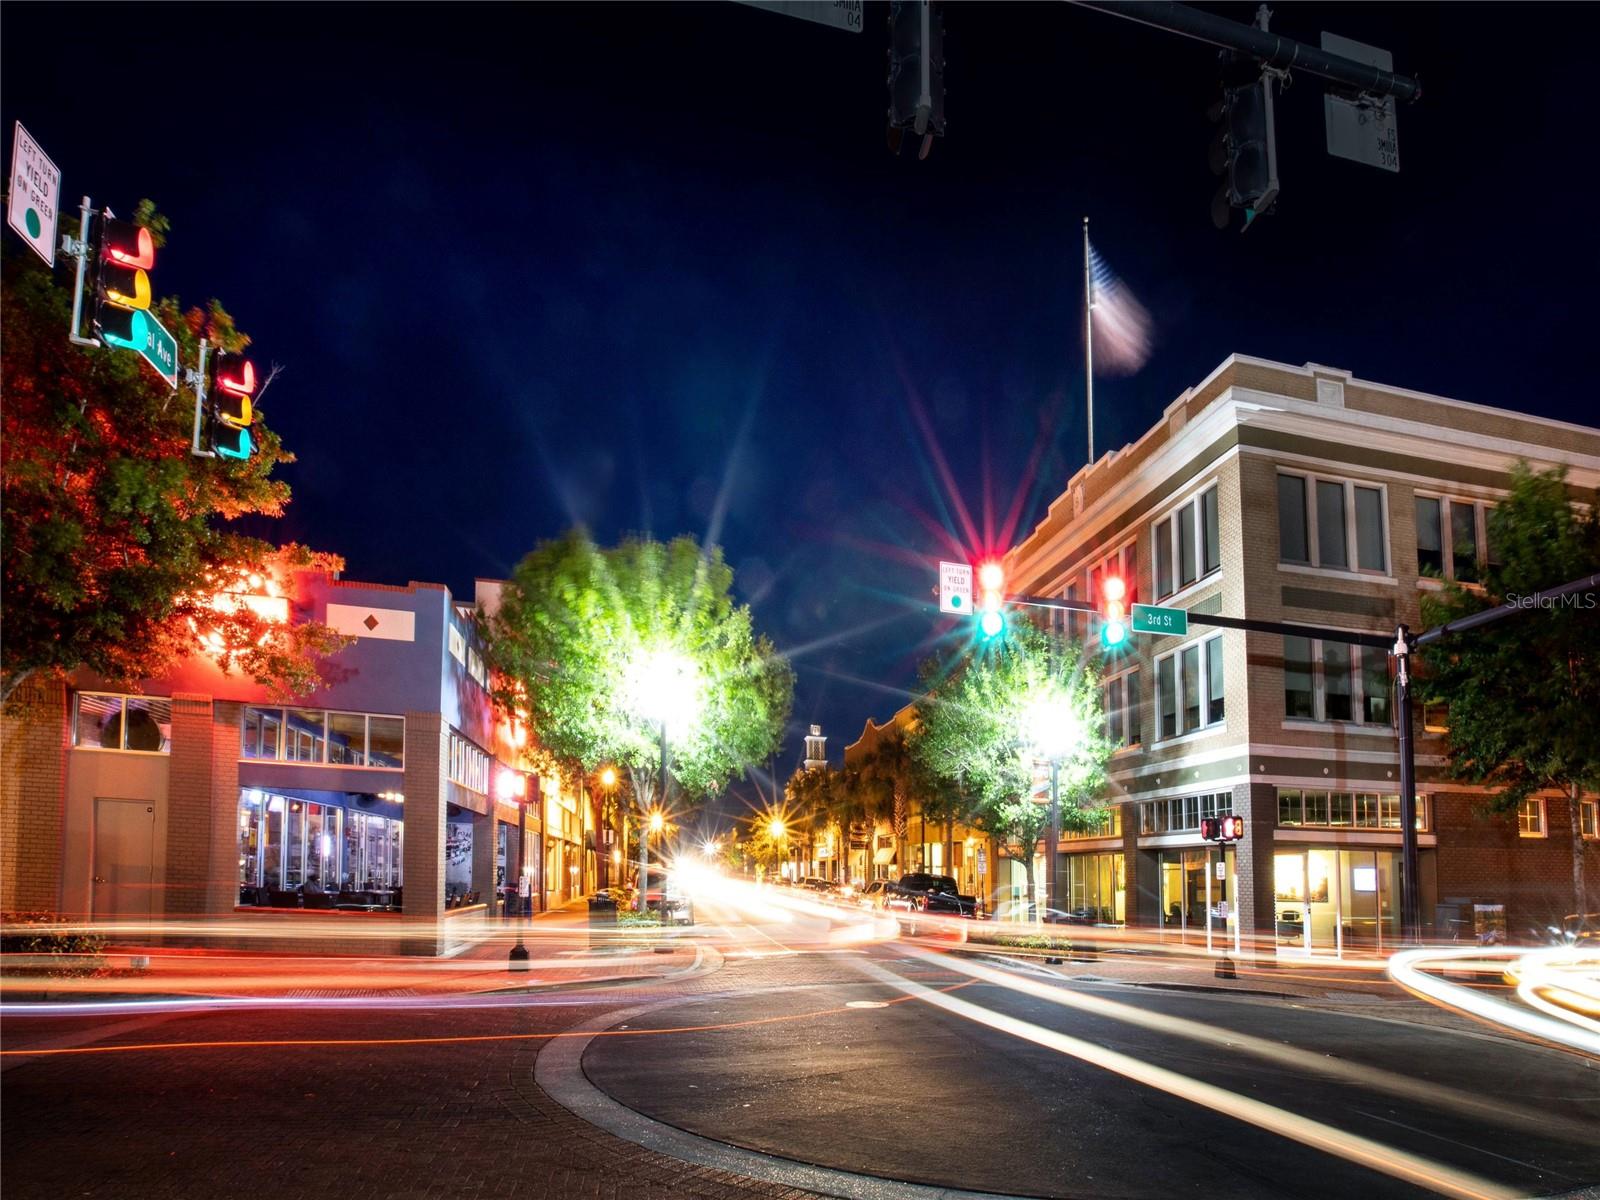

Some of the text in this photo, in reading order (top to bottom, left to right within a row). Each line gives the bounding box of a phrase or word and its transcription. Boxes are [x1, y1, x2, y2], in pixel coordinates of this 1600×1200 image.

[19, 134, 57, 187] LEFT TURN
[26, 160, 49, 198] YIELD
[17, 175, 53, 221] ON GREEN
[157, 340, 172, 367] Ave
[948, 575, 965, 585] YIELD
[1147, 613, 1172, 627] 3rd St
